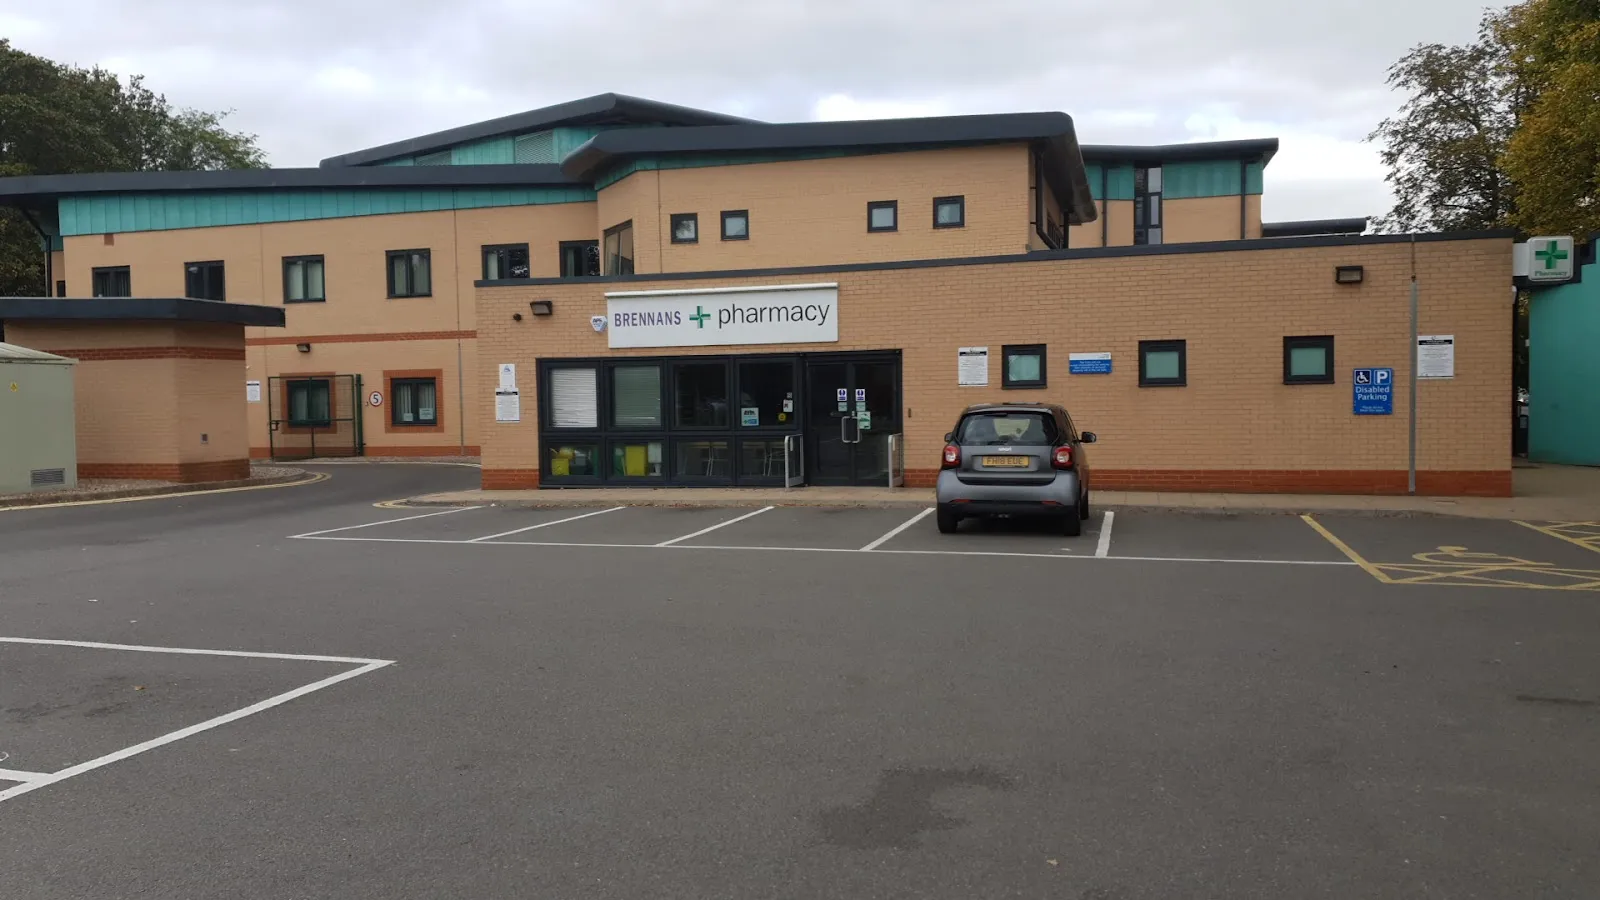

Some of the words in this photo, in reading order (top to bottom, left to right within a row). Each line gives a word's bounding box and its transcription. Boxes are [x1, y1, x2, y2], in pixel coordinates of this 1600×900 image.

[614, 311, 682, 327] BRENNANS
[718, 303, 830, 329] pharmacy
[1376, 371, 1388, 384] P
[372, 393, 380, 405] 5
